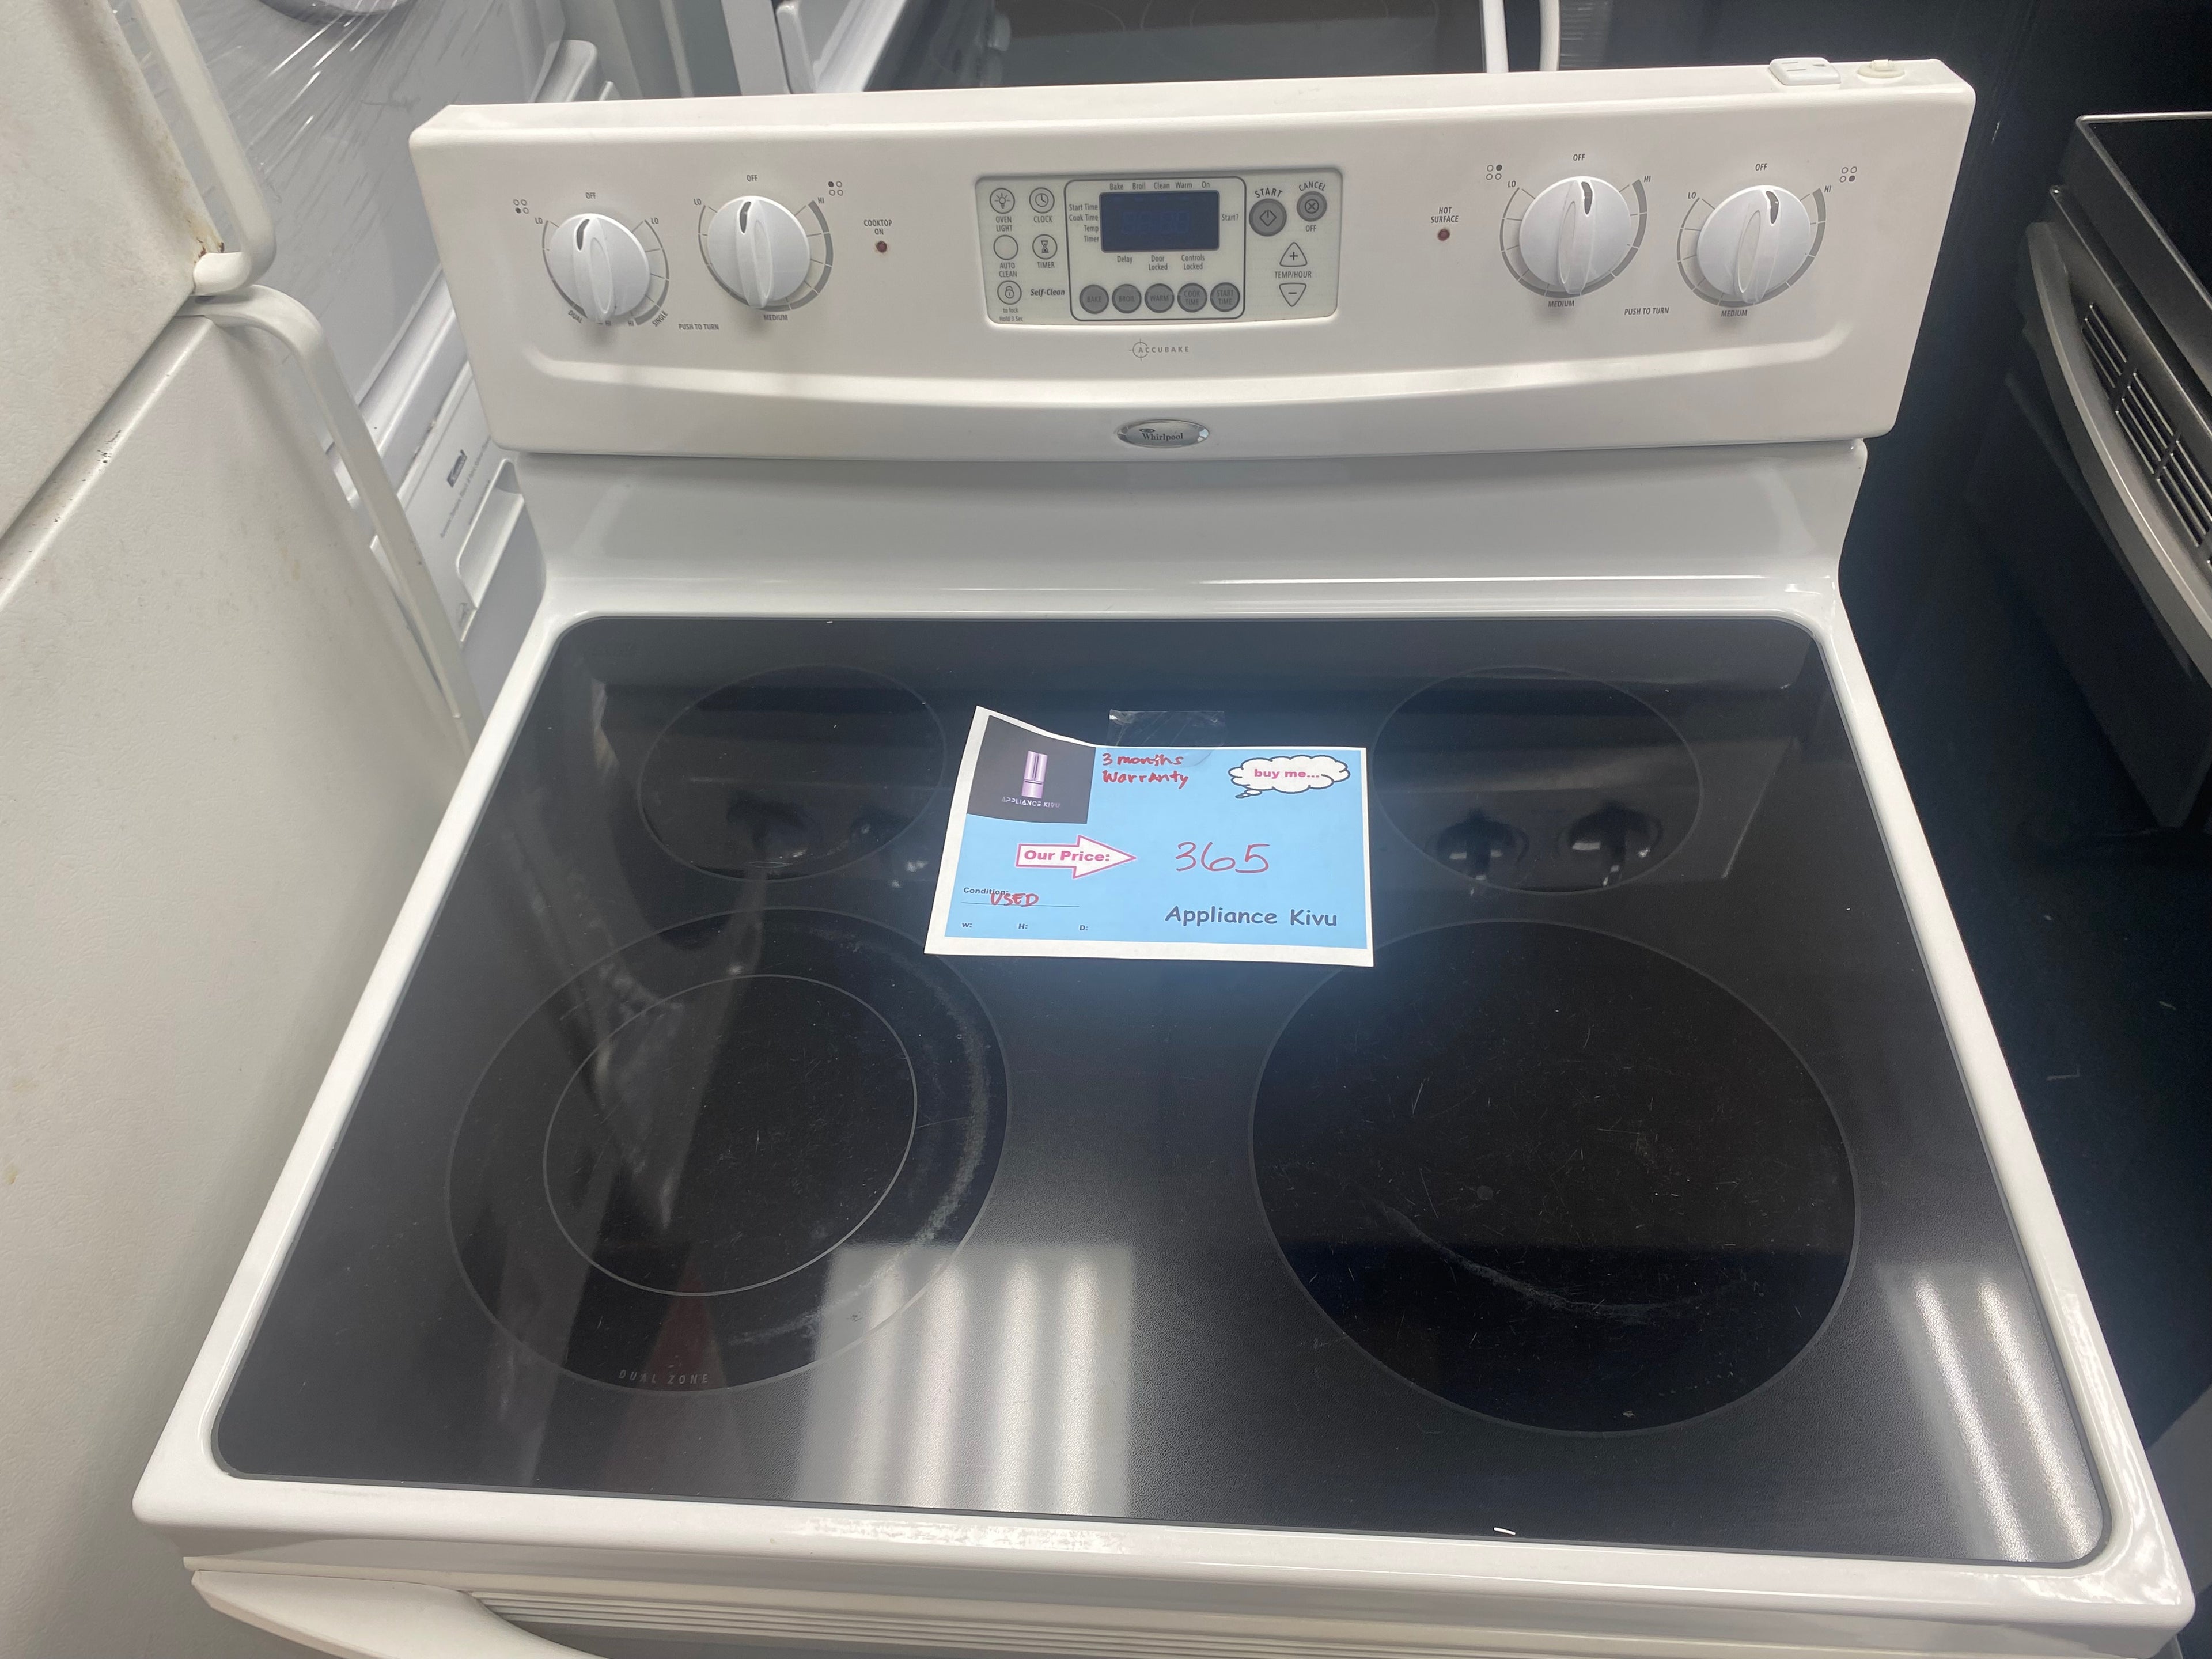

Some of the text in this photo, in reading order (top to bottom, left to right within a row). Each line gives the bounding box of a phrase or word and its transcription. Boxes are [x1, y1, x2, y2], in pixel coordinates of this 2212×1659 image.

[1755, 163, 1768, 171] OFF
[1508, 180, 1517, 188] LO
[1643, 175, 1651, 183] HI
[1298, 181, 1326, 191] CANCEL
[1255, 187, 1283, 198] START
[1430, 215, 1459, 224] SURFACE
[1117, 255, 1133, 264] Delay
[1181, 253, 1205, 262] Controls
[1274, 270, 1312, 279] TEMP/HOUR
[1030, 289, 1065, 297] Self-Clean
[1548, 300, 1575, 308] MEDIUM
[1624, 306, 1669, 316] PUSH TO TURN
[1721, 309, 1748, 317] MEDIUM
[567, 309, 583, 324] DUAL
[652, 310, 668, 327] SINGLE
[1142, 433, 1183, 441] Whirlpool
[1102, 753, 1184, 767] 3 months
[1254, 768, 1320, 781] buy me...
[1024, 850, 1110, 863] Our Price:
[1175, 842, 1270, 874] 365
[963, 887, 1009, 897] Condition:
[990, 892, 1039, 908] USED
[1165, 905, 1338, 927] Appliance Kivu
[618, 1369, 709, 1385] DUAL ZONE
